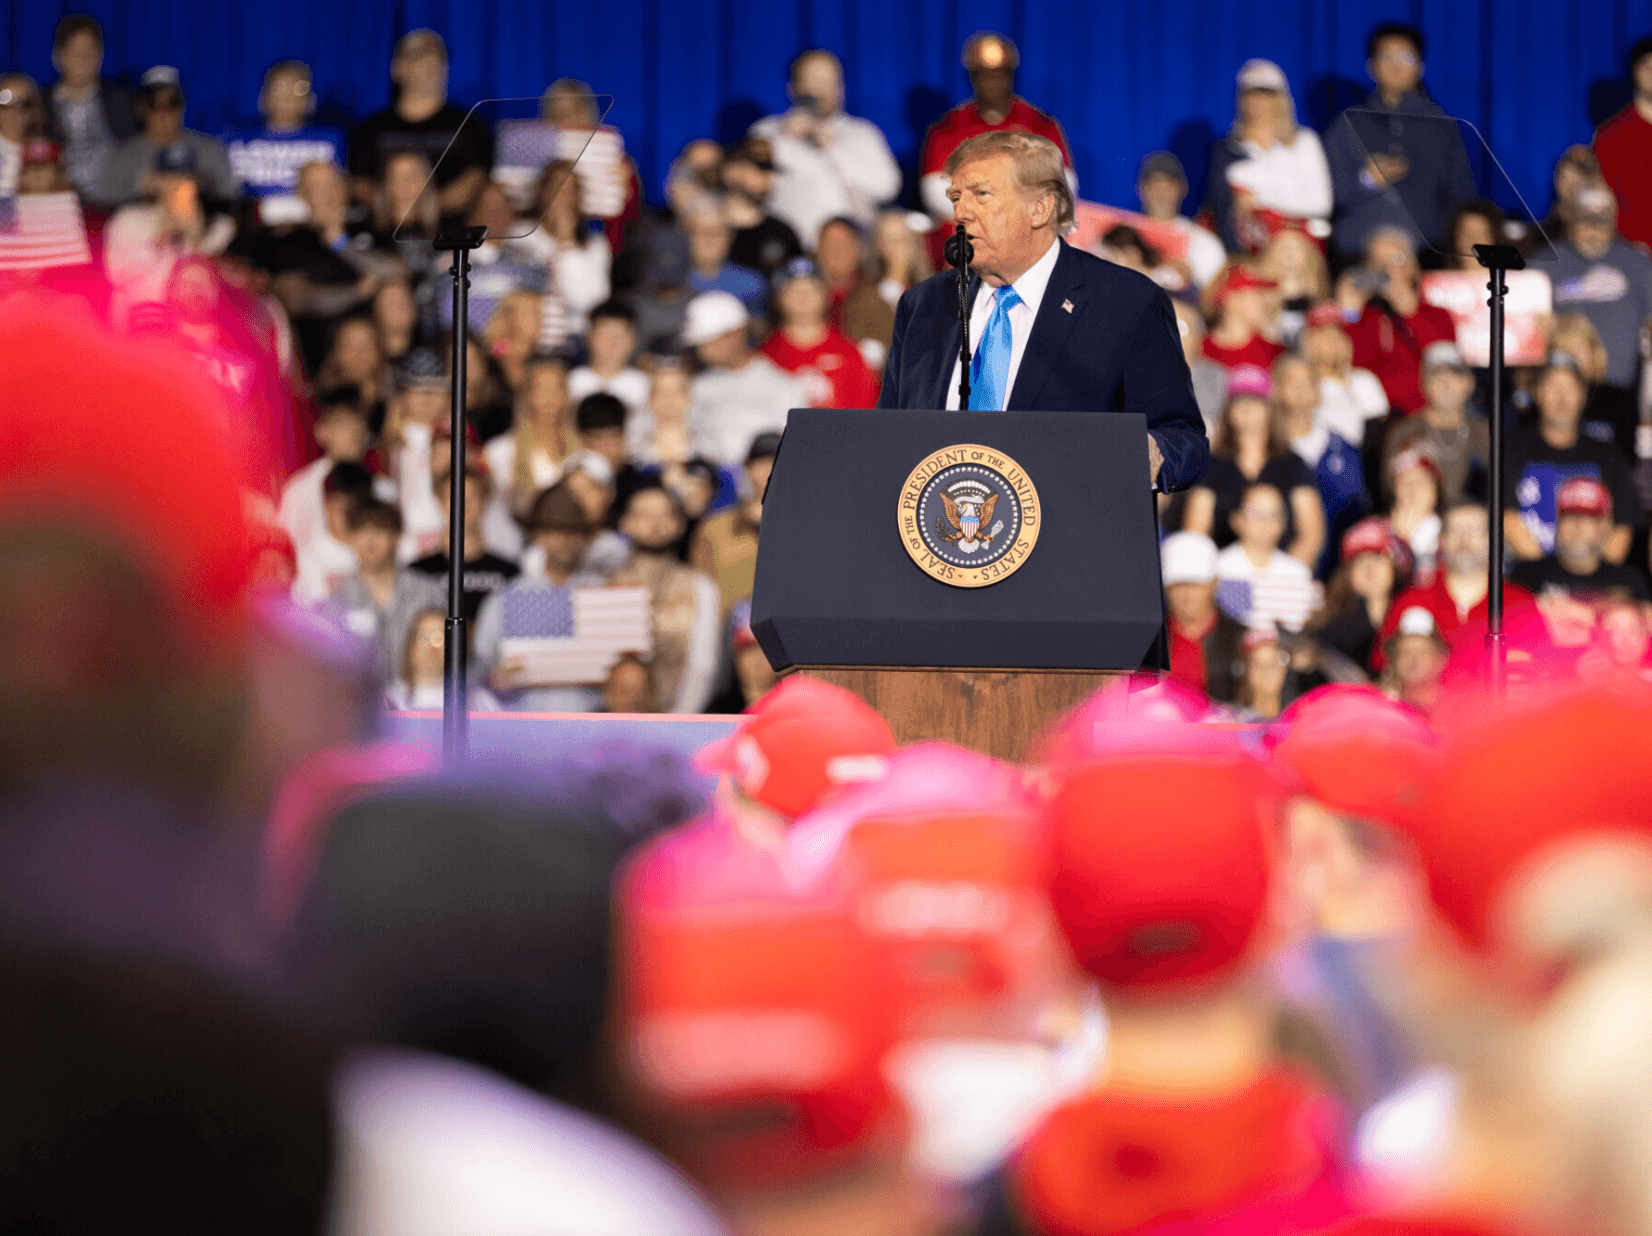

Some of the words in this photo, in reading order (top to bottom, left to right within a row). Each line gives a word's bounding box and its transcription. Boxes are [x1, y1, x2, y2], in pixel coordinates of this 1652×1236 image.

[970, 451, 985, 461] OF
[987, 454, 1005, 469] THE
[903, 449, 967, 511] PRESIDENT
[1006, 468, 1036, 526] UNITED
[904, 515, 915, 535] THE
[909, 537, 921, 550] OF
[919, 548, 956, 579] SEAL
[980, 538, 1029, 580] STATES
